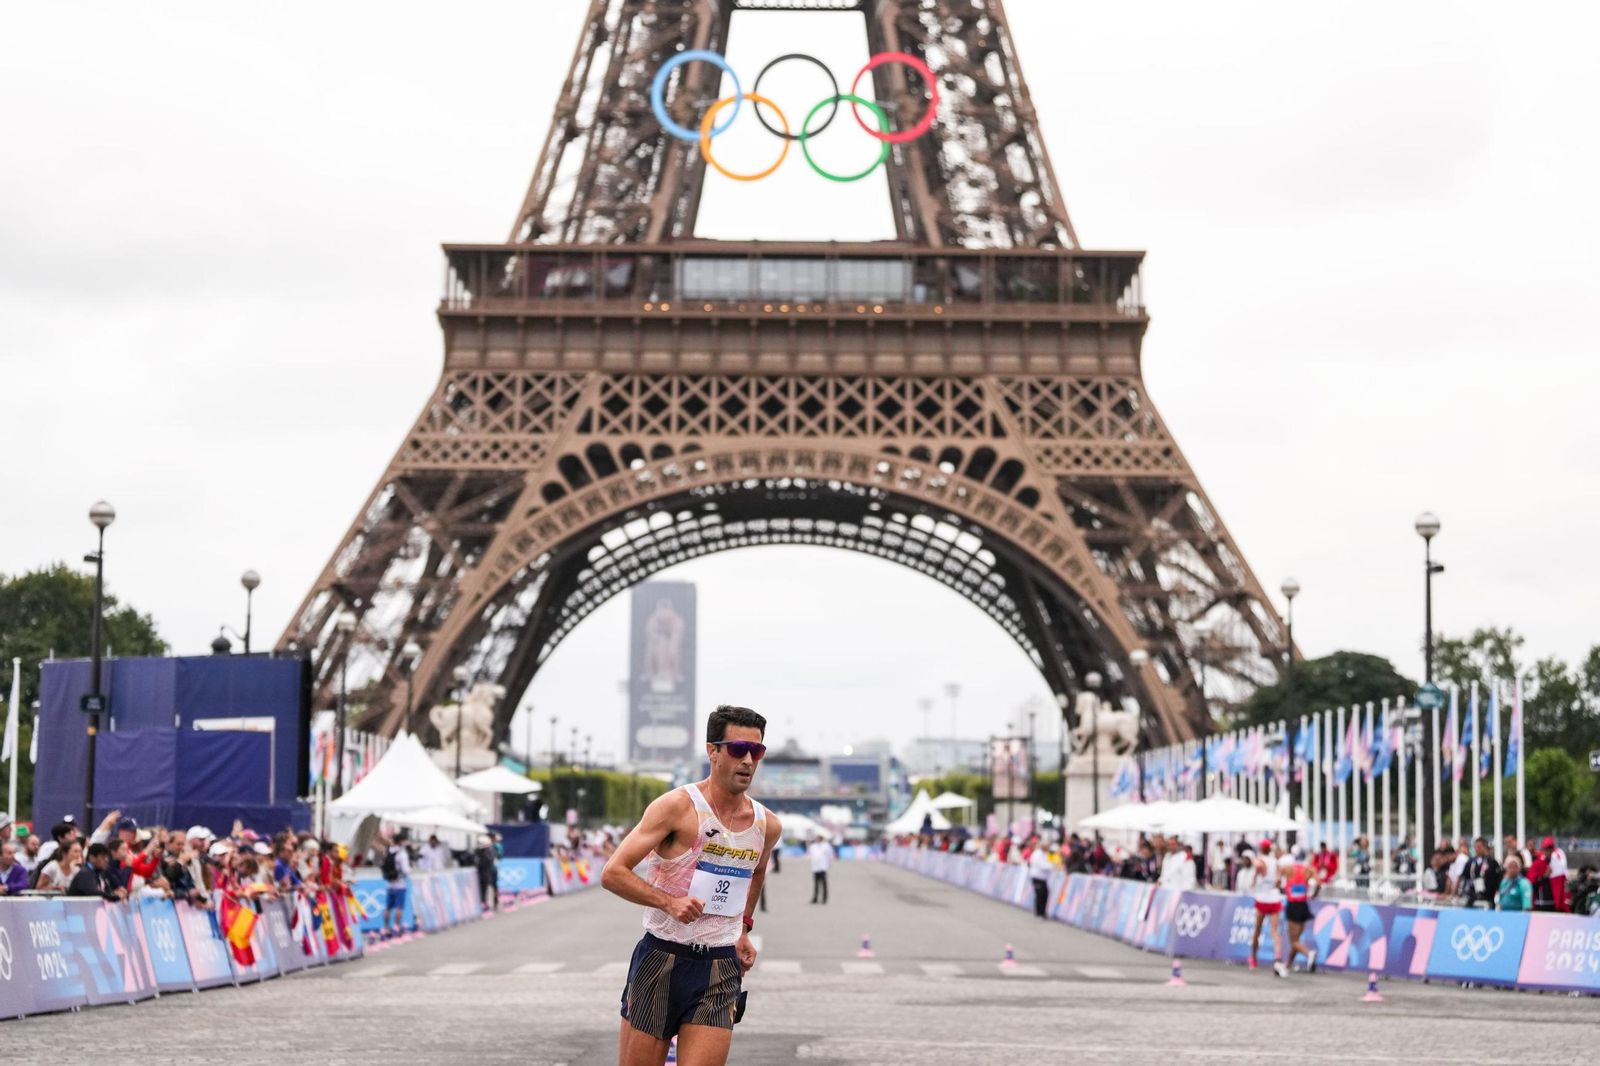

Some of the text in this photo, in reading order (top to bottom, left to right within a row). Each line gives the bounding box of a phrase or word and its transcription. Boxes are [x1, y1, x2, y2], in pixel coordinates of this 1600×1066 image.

[703, 843, 760, 861] ESPAÑA
[711, 895, 728, 903] LOPEZ
[715, 880, 730, 894] 32
[29, 920, 61, 948] PARIS
[1547, 927, 1600, 951] PARIS
[37, 951, 69, 980] 2024
[1544, 950, 1599, 974] 2024
